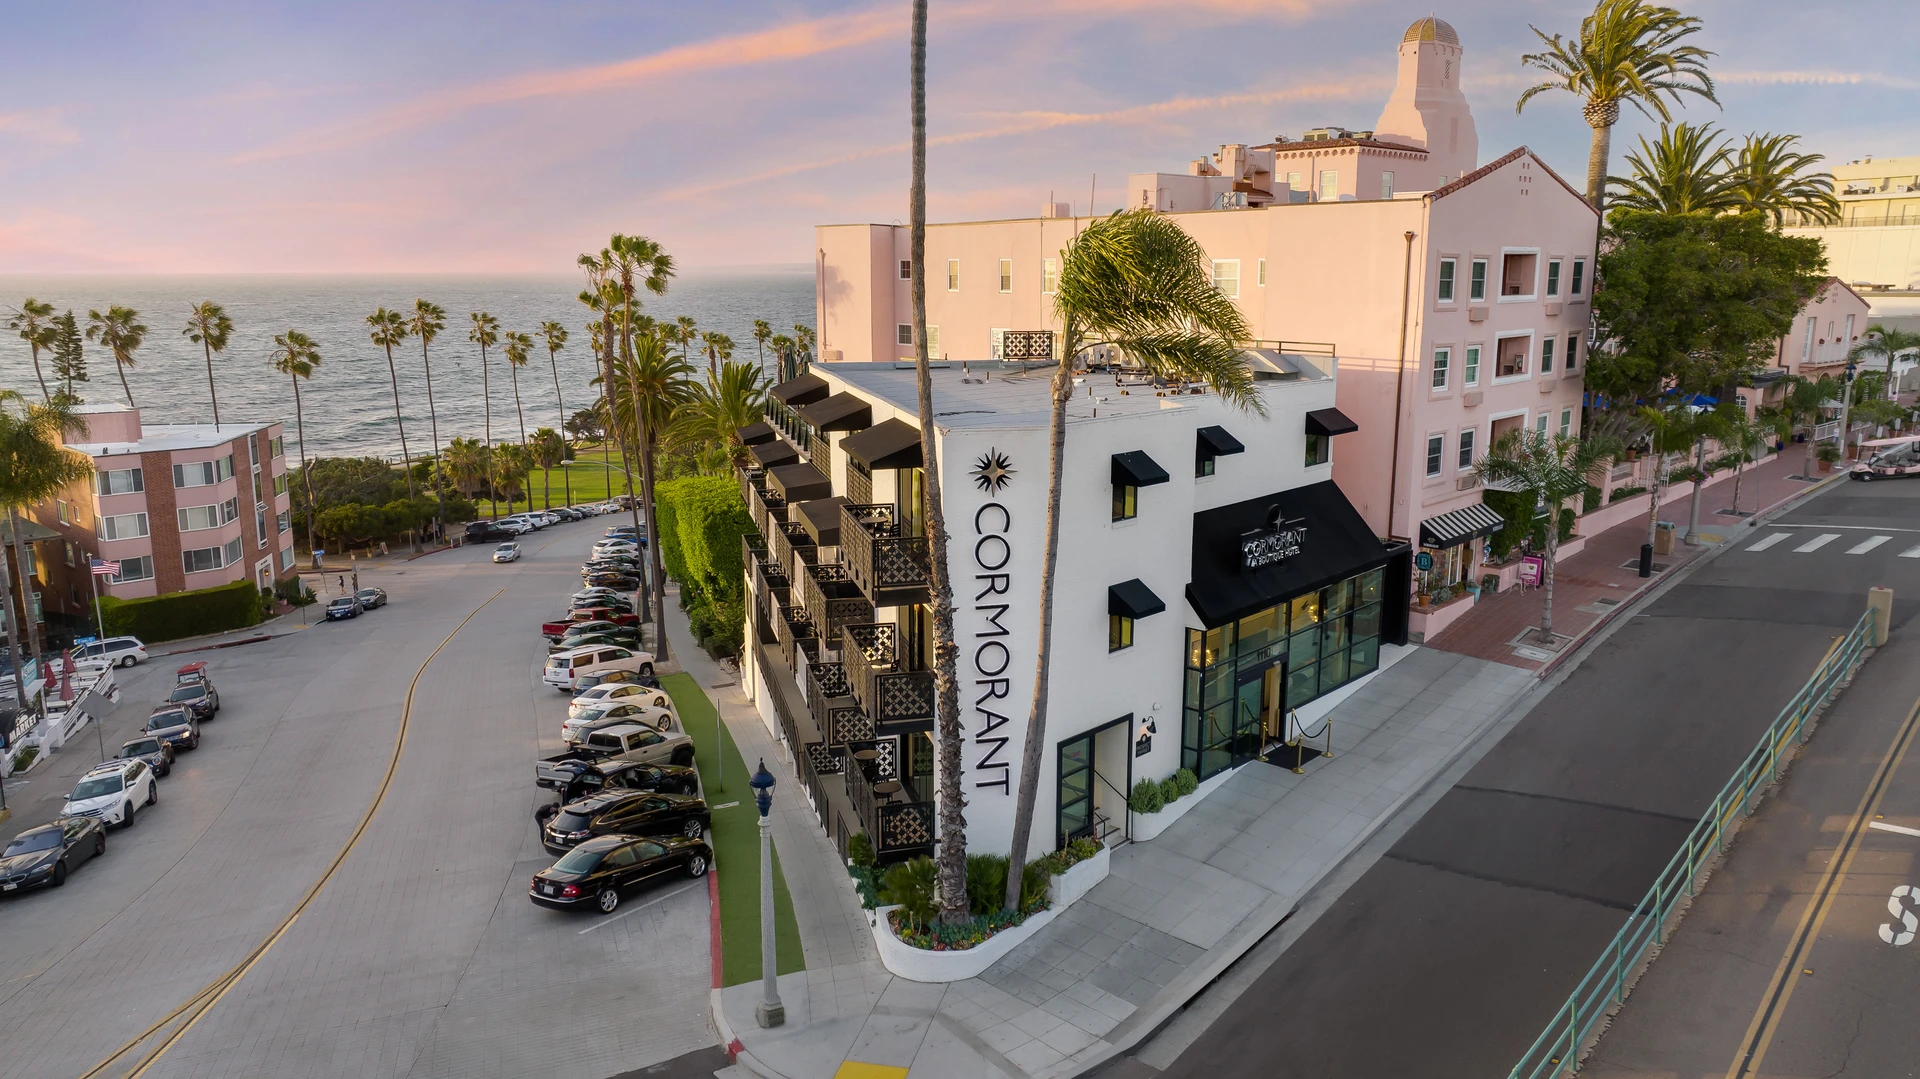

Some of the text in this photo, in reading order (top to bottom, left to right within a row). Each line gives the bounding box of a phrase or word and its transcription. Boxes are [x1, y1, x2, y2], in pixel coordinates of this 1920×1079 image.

[1244, 528, 1307, 558] CORMORANT
[974, 502, 1011, 797] CORMORANT
[9, 713, 37, 744] MARKET
